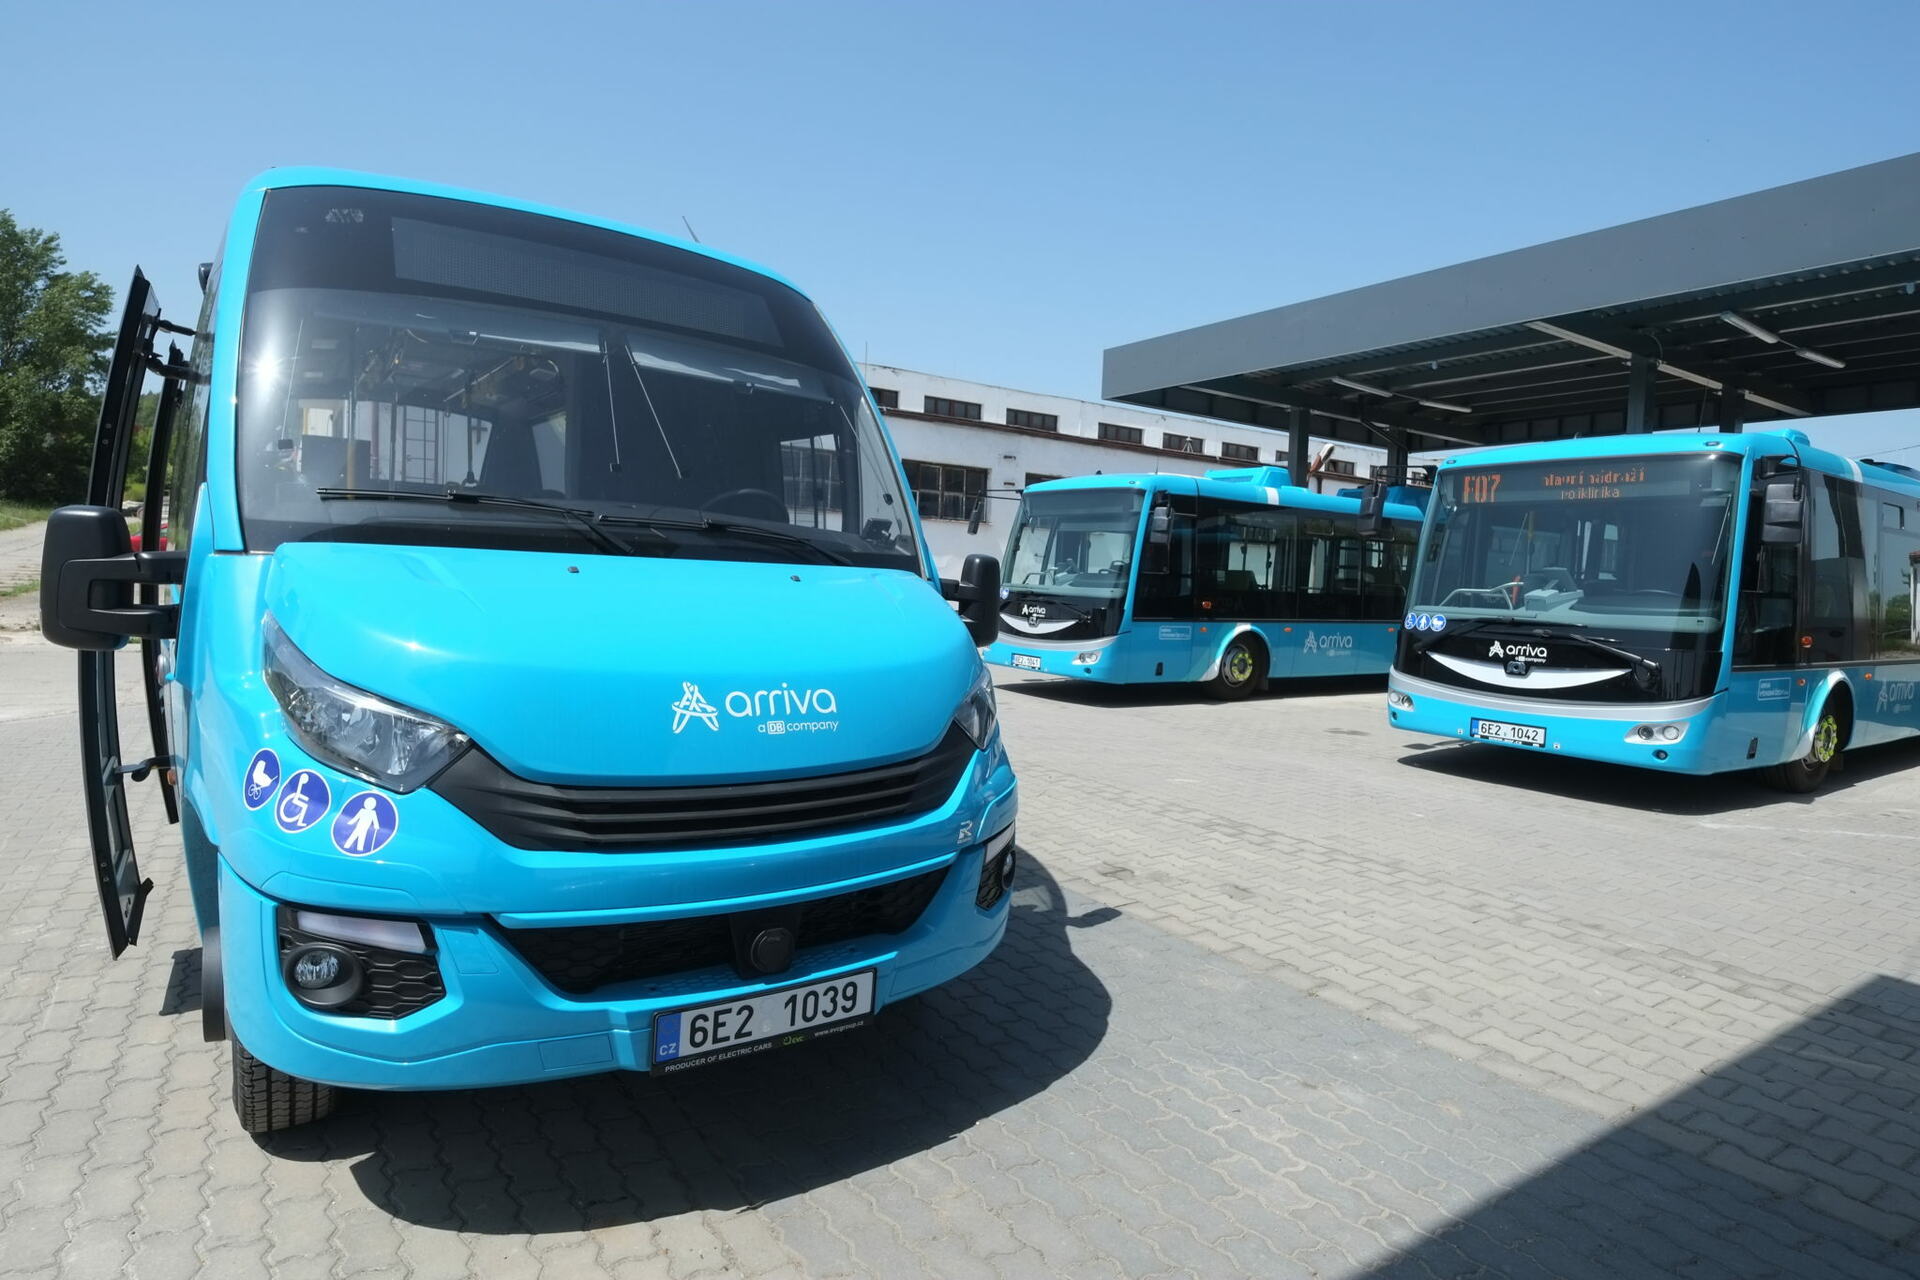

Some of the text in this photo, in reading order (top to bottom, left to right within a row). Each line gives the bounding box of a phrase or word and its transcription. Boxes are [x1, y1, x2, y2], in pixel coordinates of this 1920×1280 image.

[1319, 631, 1353, 649] arriva
[1506, 643, 1547, 657] arriva
[725, 682, 837, 717] arriva
[757, 720, 839, 735] a DB company
[1481, 723, 1501, 736] 6E2
[1511, 727, 1539, 742] 1042
[659, 981, 858, 1056] CZ 6E2 1039
[665, 1058, 706, 1073] PRODUCER
[707, 1055, 717, 1063] OF
[718, 1046, 753, 1060] ELECTRIC
[753, 1042, 773, 1053] CARS
